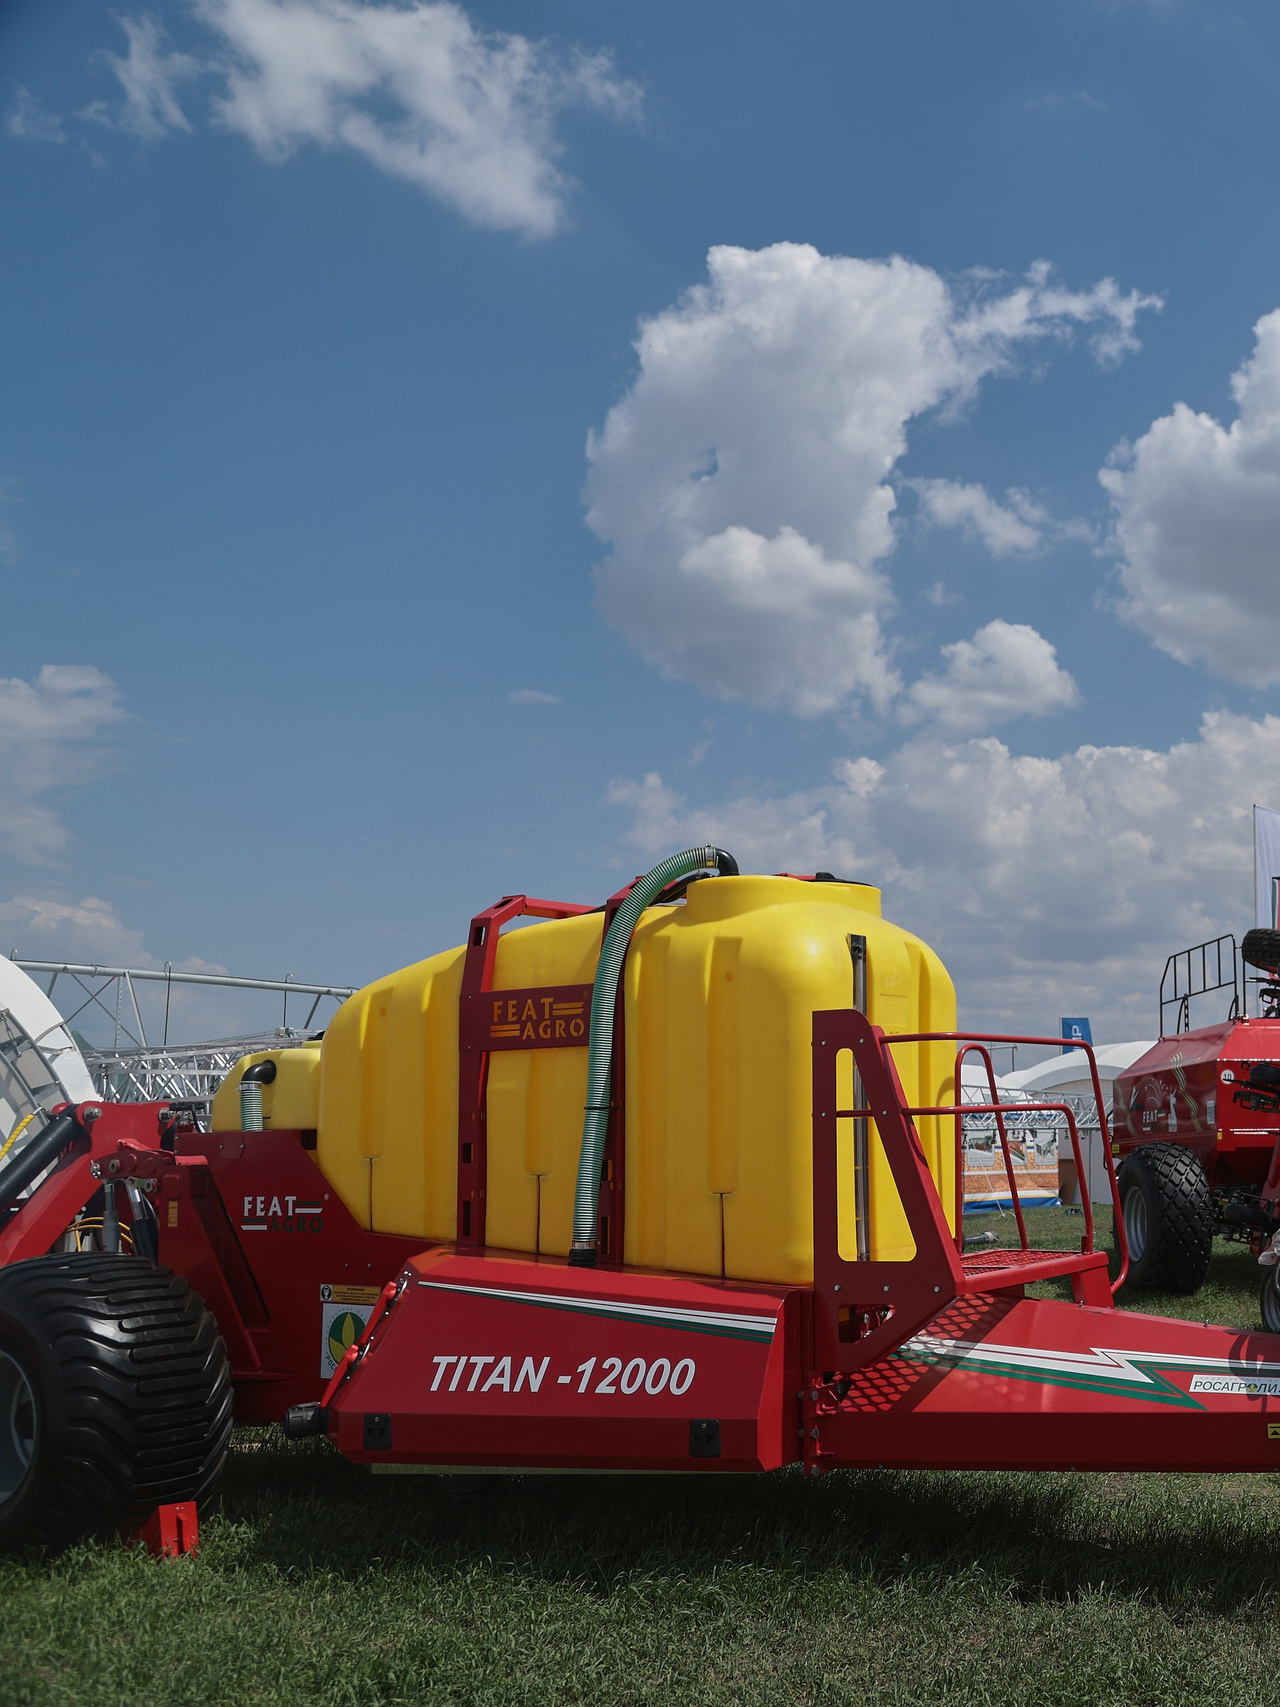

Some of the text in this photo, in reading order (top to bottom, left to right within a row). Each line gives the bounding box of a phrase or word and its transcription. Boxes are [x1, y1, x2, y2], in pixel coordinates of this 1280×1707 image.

[493, 997, 554, 1022] FEAT
[522, 1018, 585, 1040] AGRO
[243, 1195, 297, 1217] FEAT
[270, 1216, 324, 1234] AGRO
[429, 1356, 697, 1396] TITAN -12000
